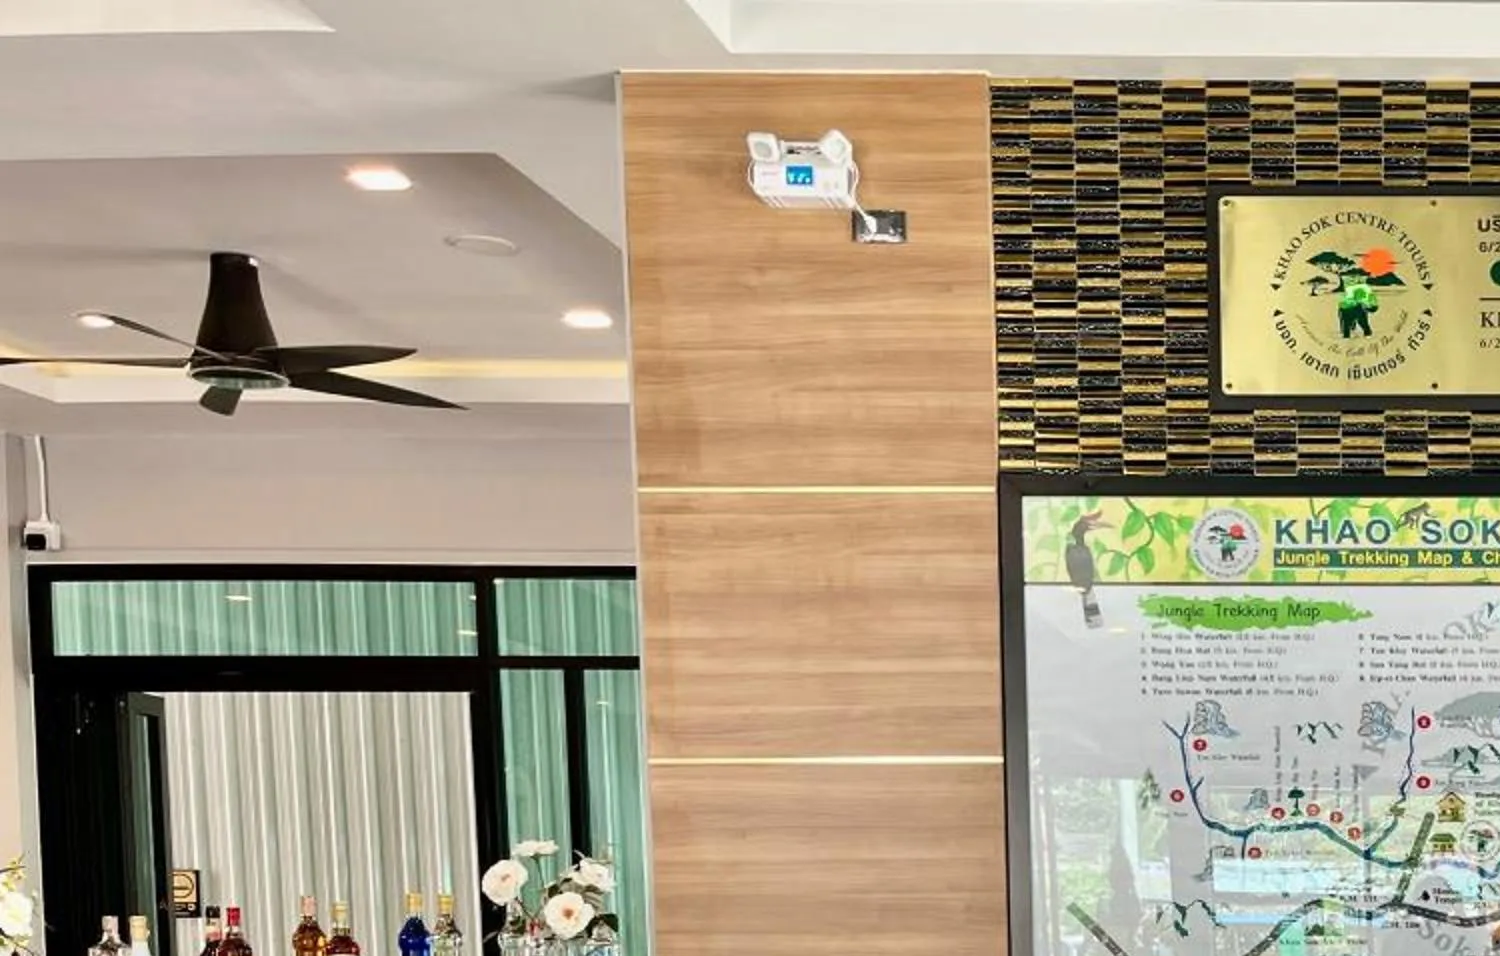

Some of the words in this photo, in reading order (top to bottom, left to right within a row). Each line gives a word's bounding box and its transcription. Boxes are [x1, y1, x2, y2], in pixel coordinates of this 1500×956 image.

[1273, 237, 1303, 280] KHAO
[1301, 216, 1333, 239] SOK
[1335, 211, 1399, 237] CENTRE
[1398, 231, 1431, 282] TOURS
[1276, 518, 1392, 545] KHAO
[1276, 550, 1330, 567] Jungle
[1340, 550, 1409, 566] Trekking
[1418, 550, 1452, 566] Map
[1462, 551, 1474, 564] &
[1158, 603, 1205, 619] Jungle
[1213, 603, 1278, 620] Trekking
[1287, 603, 1321, 619] Map
